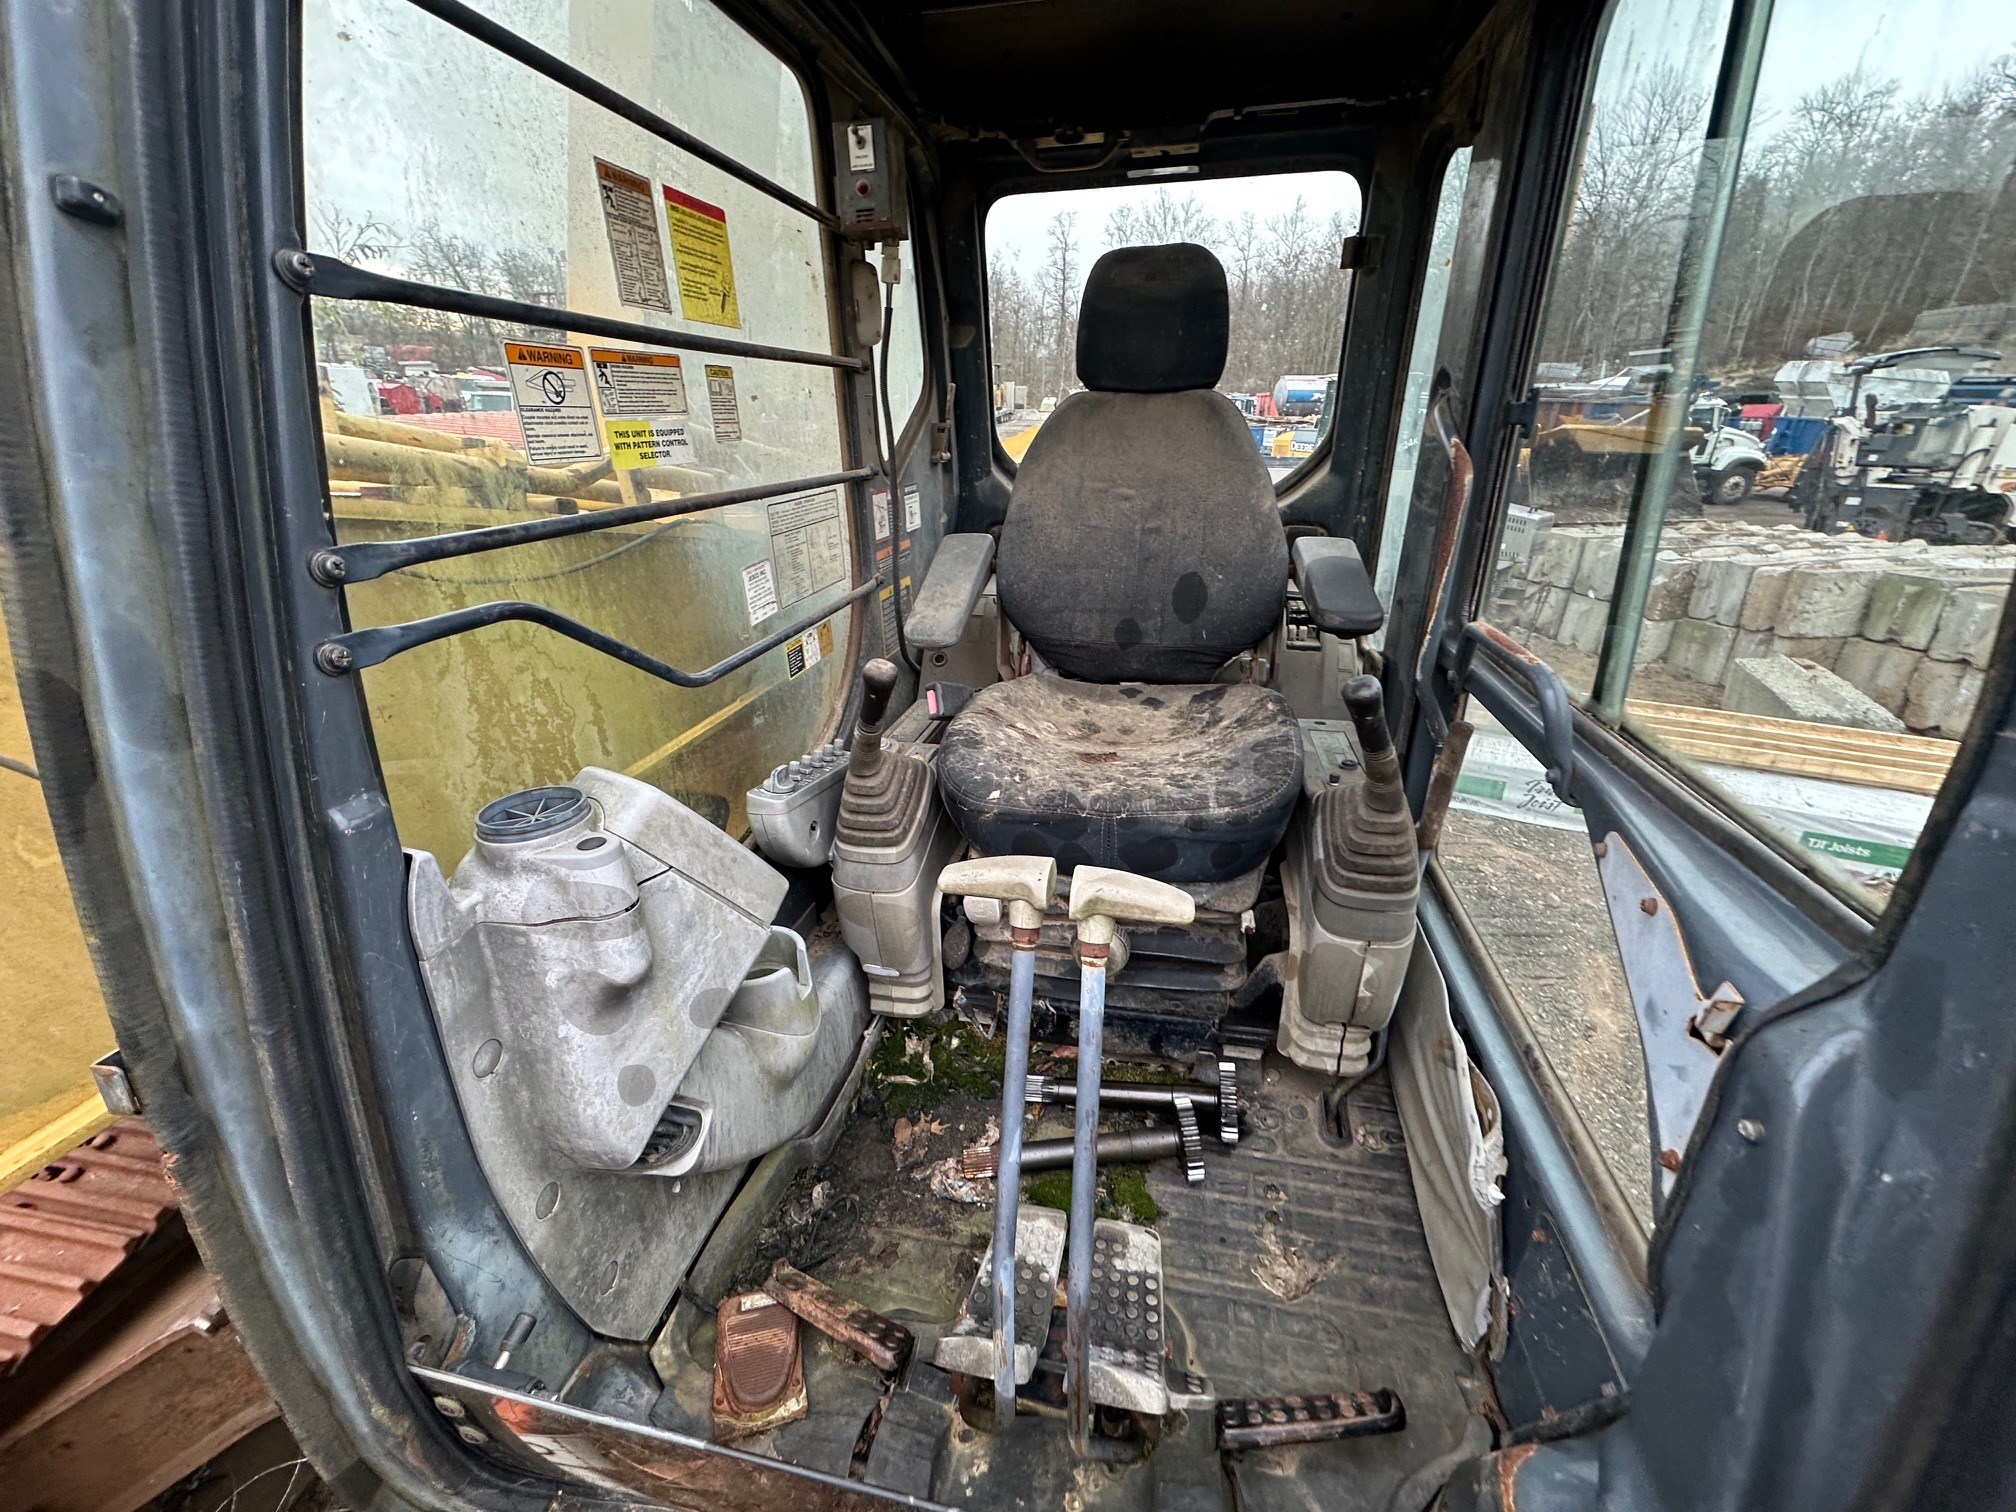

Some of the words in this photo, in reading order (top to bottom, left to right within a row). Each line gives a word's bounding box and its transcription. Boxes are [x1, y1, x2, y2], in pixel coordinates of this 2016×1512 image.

[526, 349, 574, 365] WARNING
[625, 354, 654, 364] WARNING
[709, 368, 730, 377] CAUTION
[613, 430, 630, 438] THIS
[631, 430, 647, 438] UNIT
[648, 429, 655, 437] IS
[656, 428, 685, 437] EQUIPPED
[613, 442, 632, 450] WITH
[633, 440, 661, 449] PATTERN
[661, 439, 689, 447] CONTROL
[1290, 441, 1315, 453] DEERE
[639, 450, 672, 460] SELECTOR
[1516, 793, 1563, 811] Joist
[1828, 842, 1872, 857] Joists
